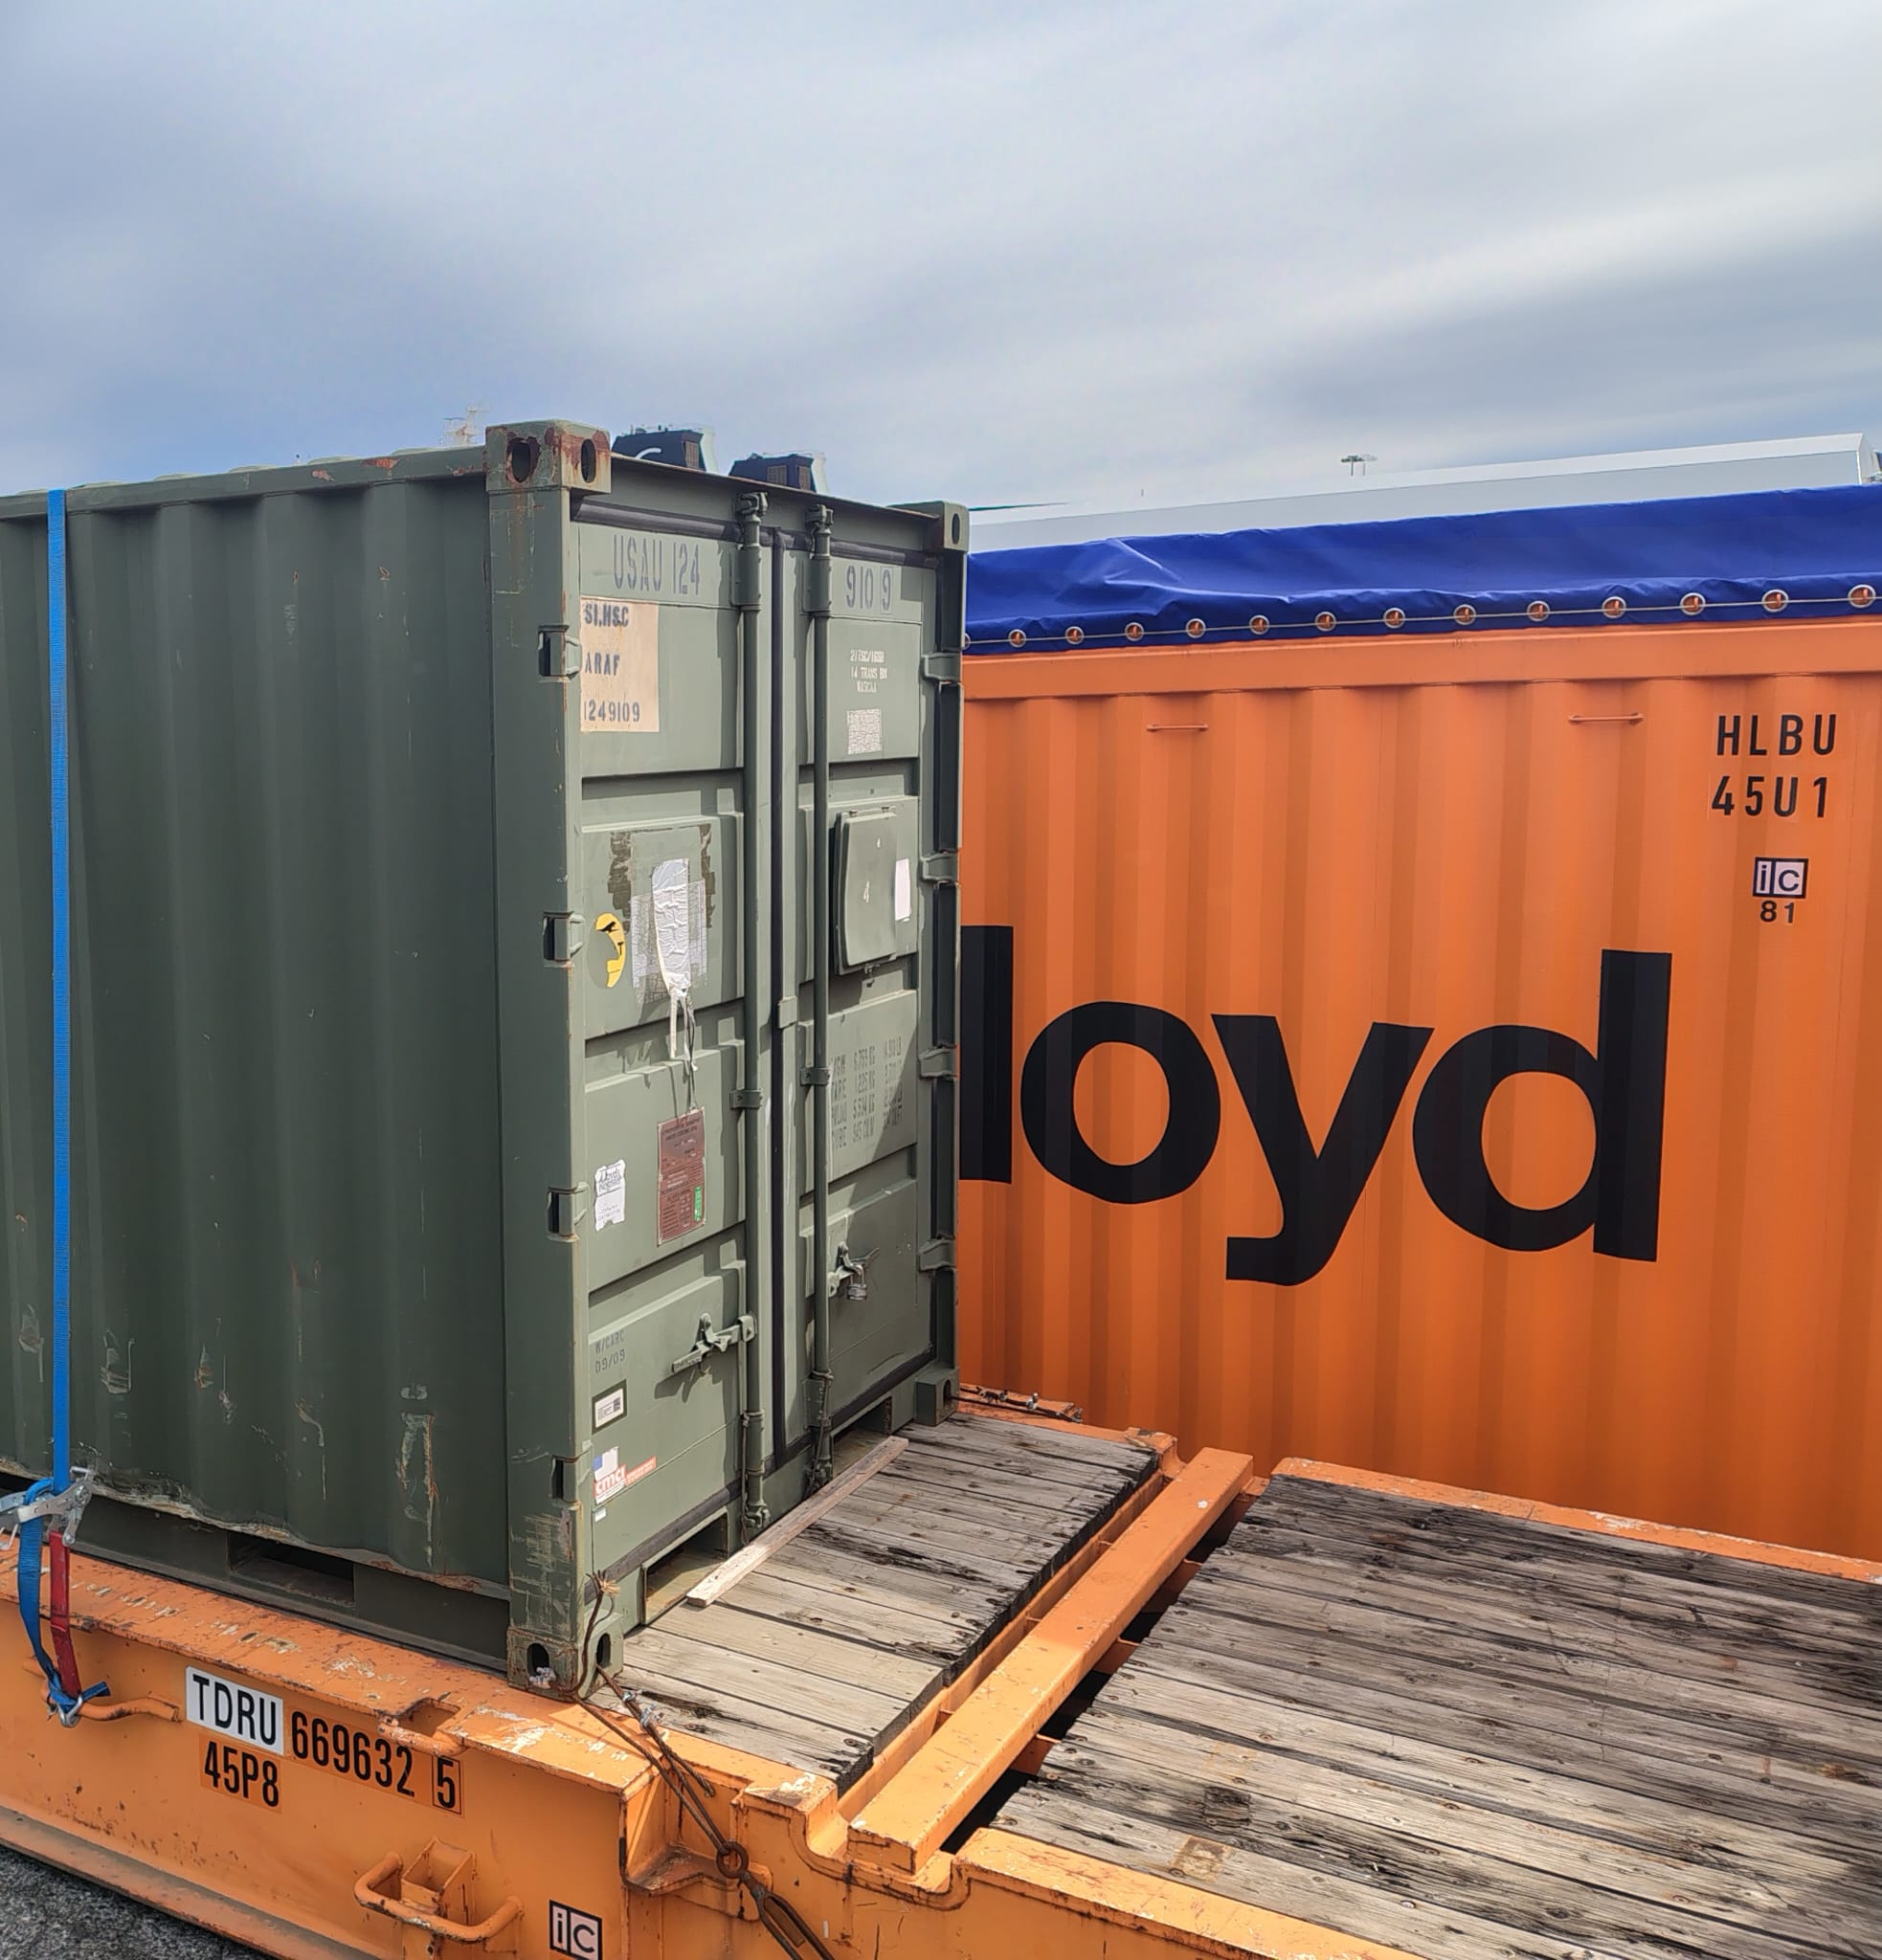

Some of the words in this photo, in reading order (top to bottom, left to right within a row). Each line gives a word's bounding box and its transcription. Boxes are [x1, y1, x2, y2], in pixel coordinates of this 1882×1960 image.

[614, 533, 663, 592] USAU
[673, 541, 700, 597] 124
[584, 652, 620, 676] ARAF
[1716, 713, 1837, 756] HLBU
[1711, 774, 1827, 818] 45U1
[1759, 900, 1795, 924] 81
[960, 924, 1673, 1286] loyd
[595, 1348, 626, 1373] 09/09
[192, 1673, 277, 1746] TDRU
[291, 1710, 414, 1797] 669632
[437, 1755, 457, 1809] 5
[204, 1740, 279, 1807] 45P8
